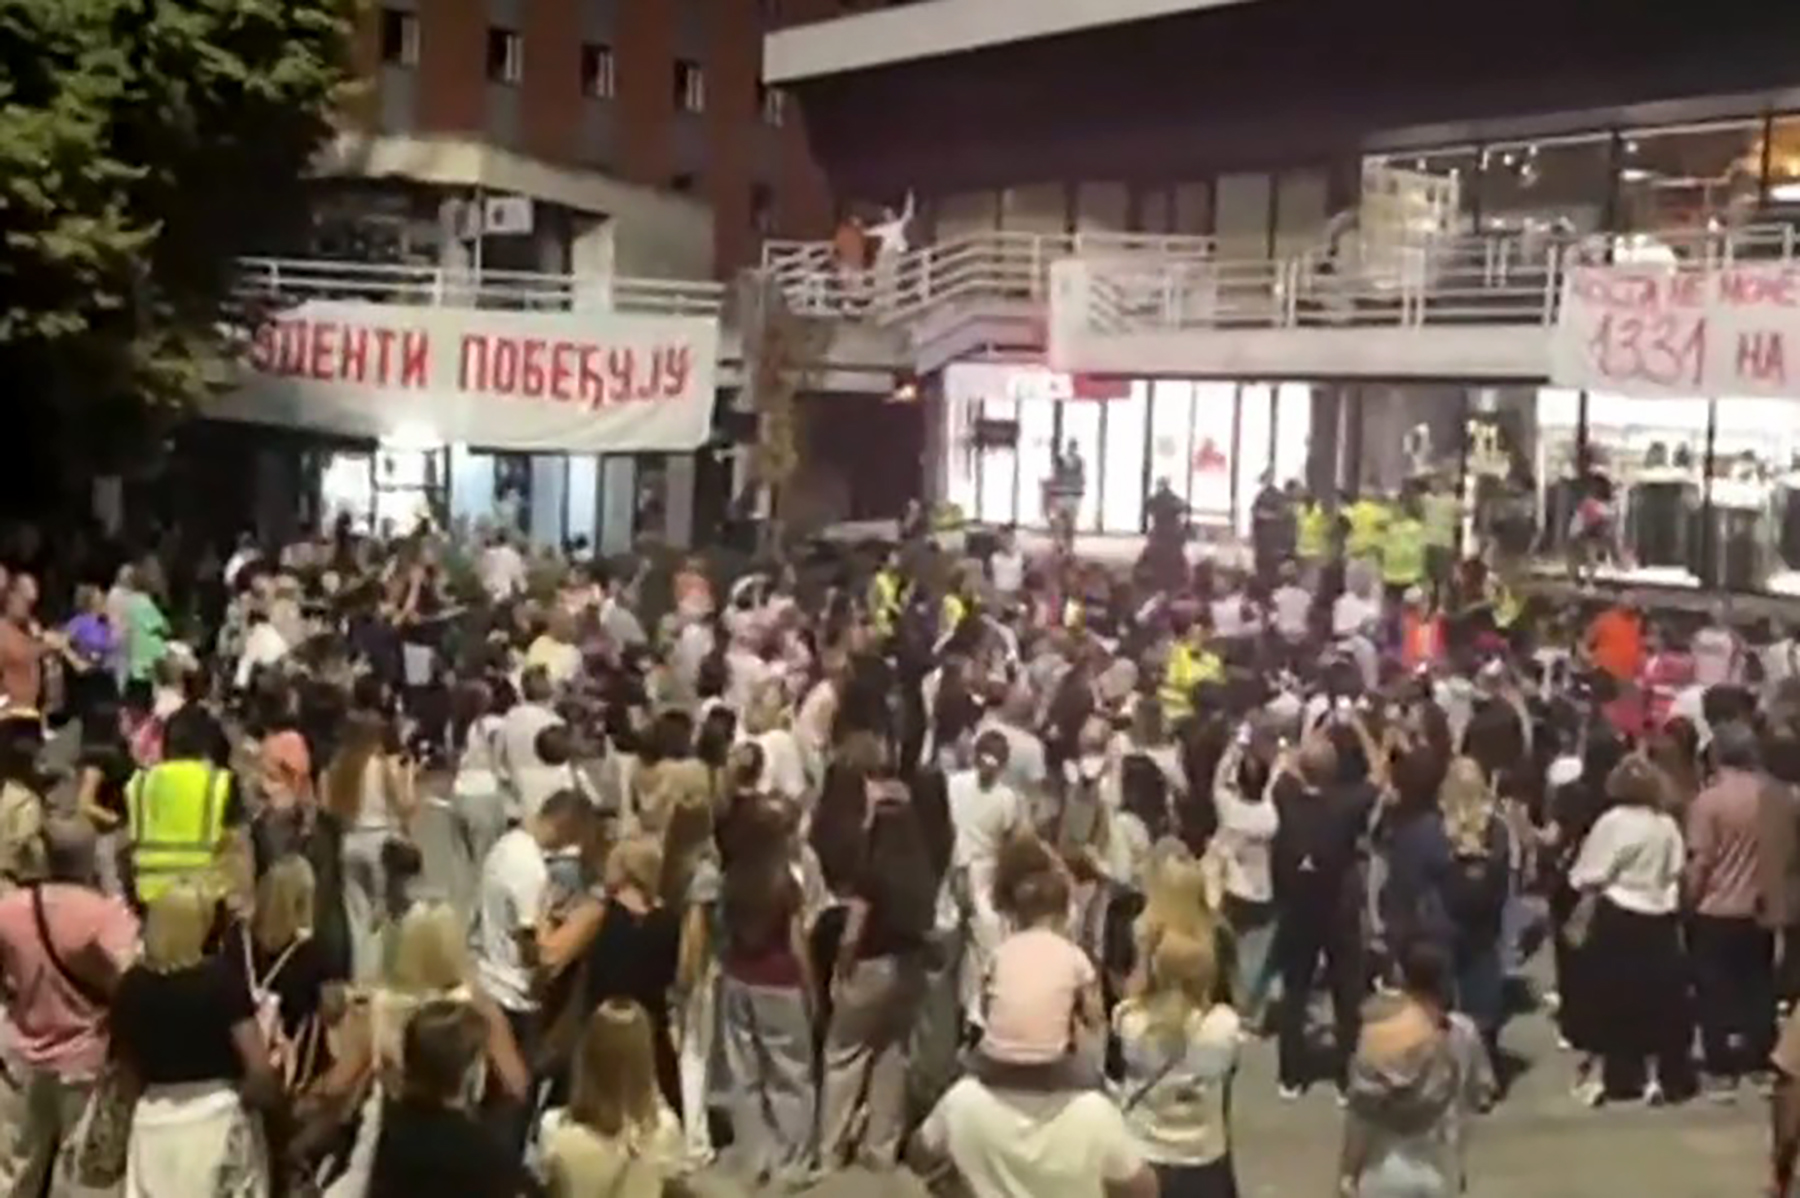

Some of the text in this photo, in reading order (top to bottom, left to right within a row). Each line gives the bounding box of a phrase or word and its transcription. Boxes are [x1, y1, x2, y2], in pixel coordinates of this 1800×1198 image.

[458, 332, 690, 408] ПОБЕЂУЈУ
[1590, 314, 1785, 388] 1331 НА
